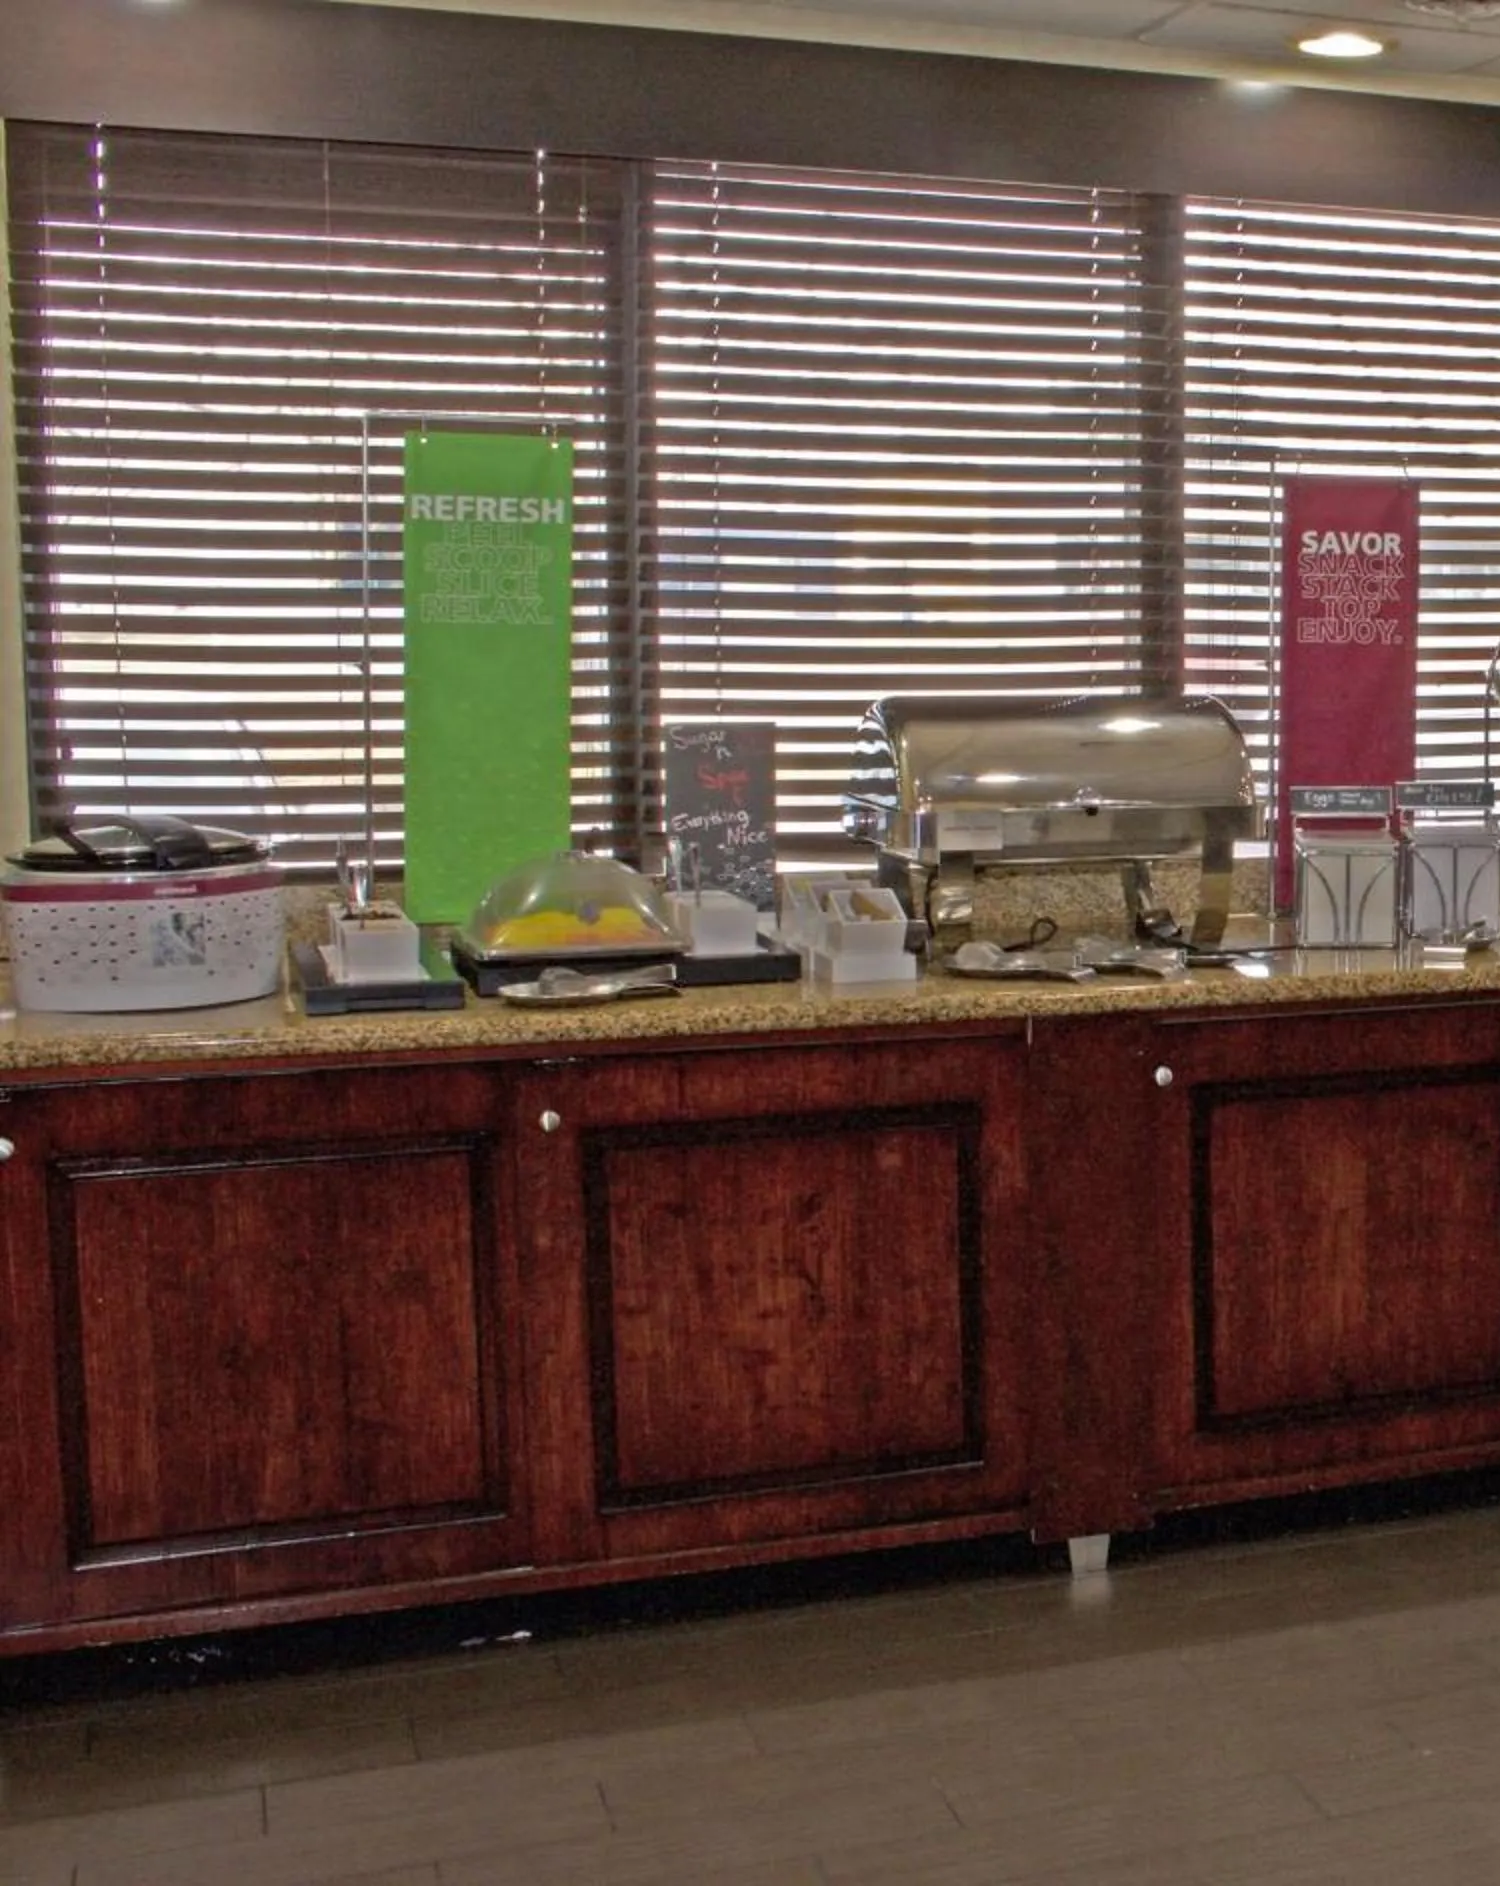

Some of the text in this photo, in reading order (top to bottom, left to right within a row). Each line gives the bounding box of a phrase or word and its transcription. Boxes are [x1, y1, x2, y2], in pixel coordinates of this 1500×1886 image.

[410, 494, 566, 525] REFRESH
[444, 522, 524, 546] PEEL
[1301, 530, 1403, 556] SAVOR
[423, 541, 554, 575] SCOOP
[1298, 553, 1405, 578] SNACK
[436, 570, 539, 598] SLICE
[1300, 574, 1401, 601] STACK
[1320, 596, 1381, 622] TOP
[1296, 617, 1404, 645] ENJOY.
[726, 825, 769, 846] Nice
